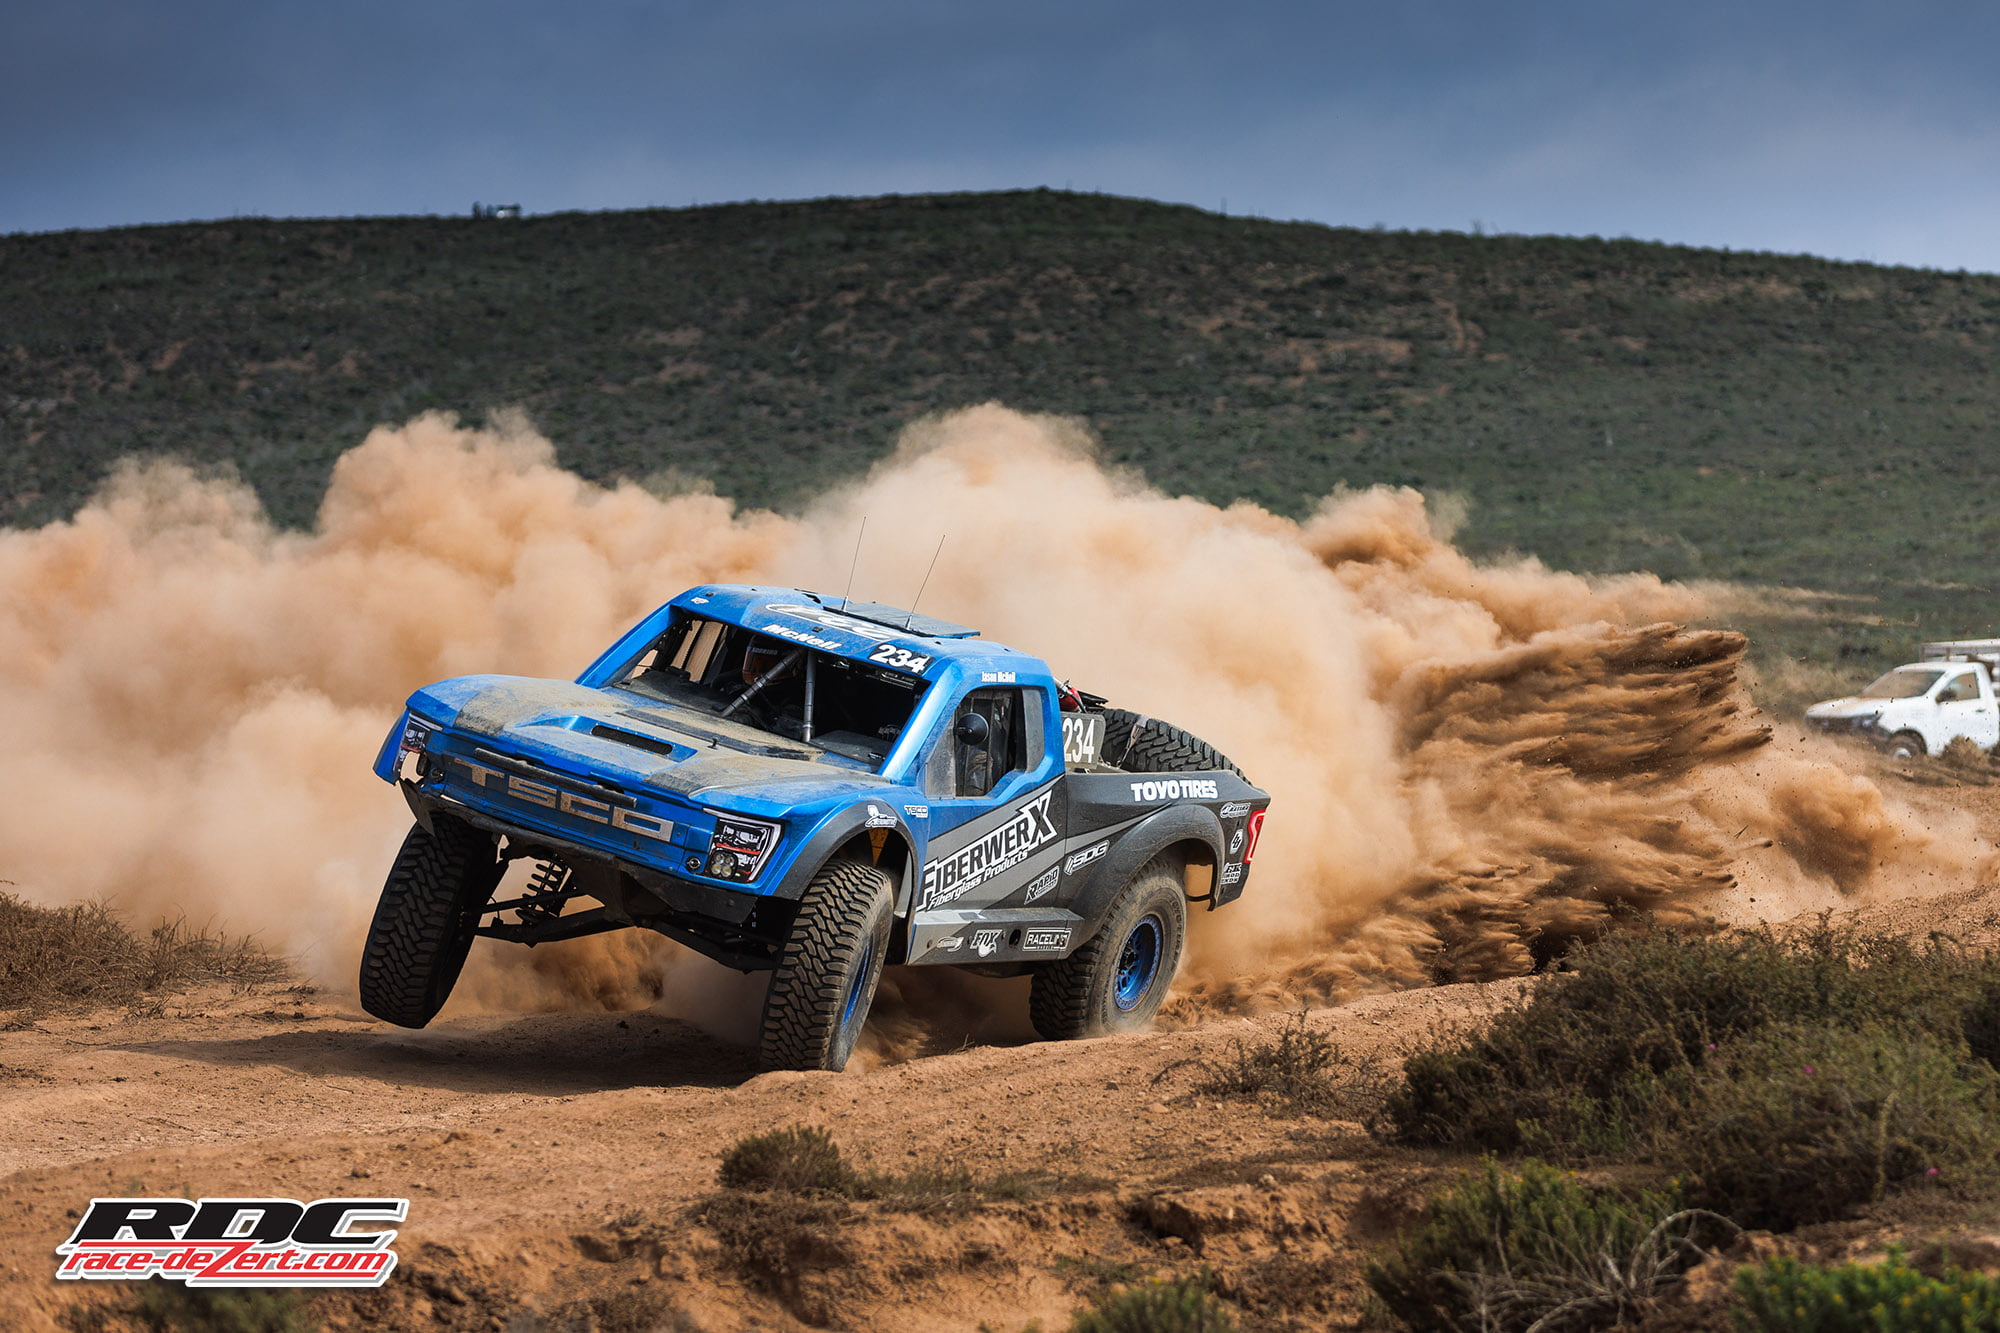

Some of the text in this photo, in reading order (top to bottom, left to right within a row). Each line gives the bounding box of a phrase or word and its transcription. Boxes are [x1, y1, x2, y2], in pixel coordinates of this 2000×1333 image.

[870, 644, 929, 674] 234
[1062, 718, 1095, 763] 234
[454, 757, 674, 842] TSCO
[1131, 780, 1218, 801] TOYO TIRES
[917, 793, 1056, 909] FIBERWERX
[927, 848, 1028, 910] Fiberglass Products
[972, 932, 999, 948] FOX
